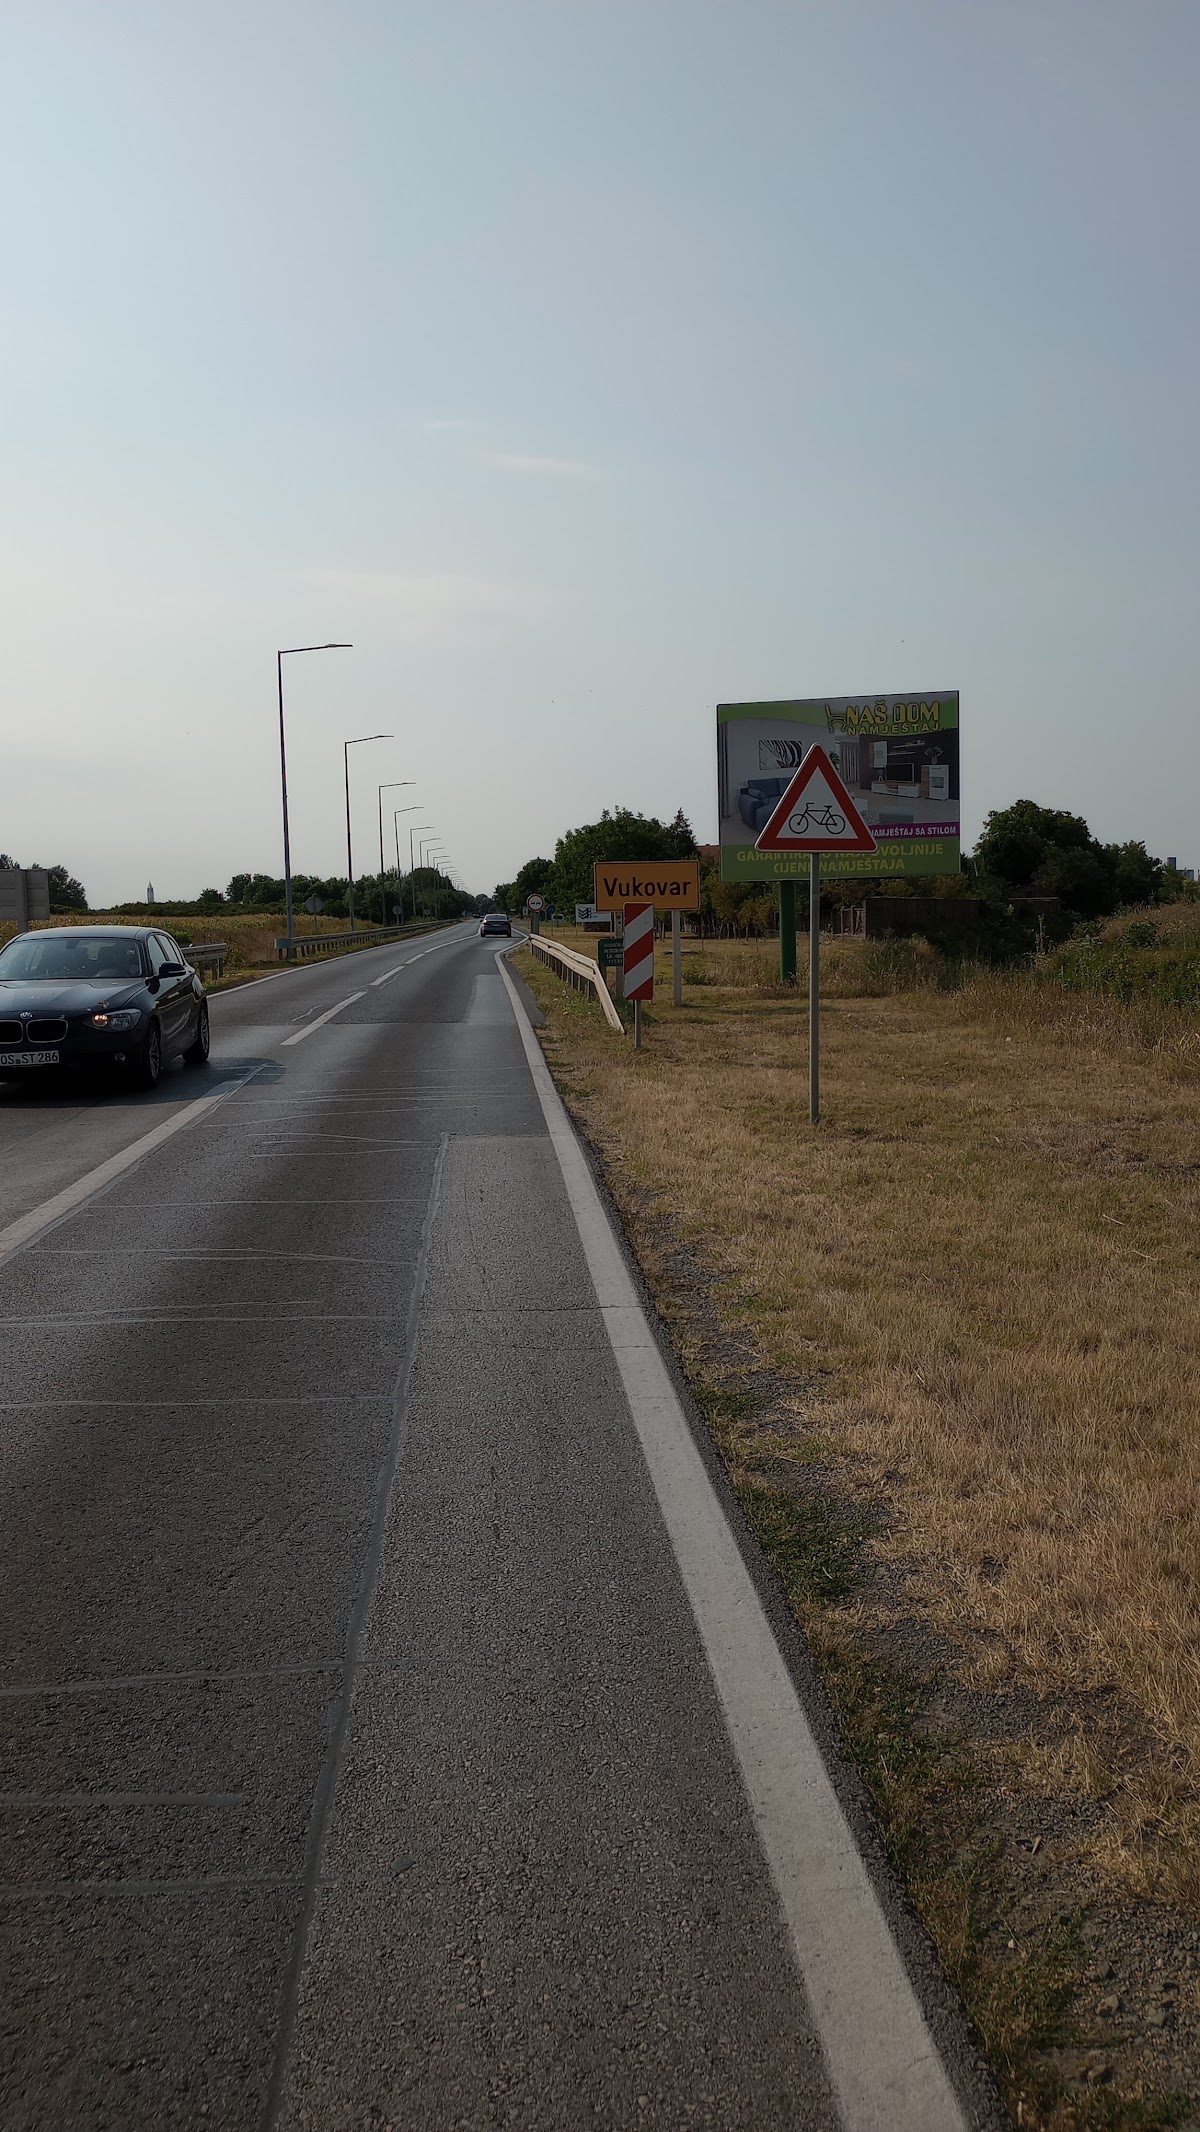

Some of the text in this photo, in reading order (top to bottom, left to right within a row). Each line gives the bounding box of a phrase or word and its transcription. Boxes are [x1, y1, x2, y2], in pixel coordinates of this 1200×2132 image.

[846, 700, 940, 726] NAŠ DOM
[848, 722, 940, 736] NAMJEŠTAJ
[915, 827, 926, 836] SA
[927, 825, 957, 835] STILOM
[603, 876, 692, 897] Vukovar
[38, 1052, 58, 1063] 286
